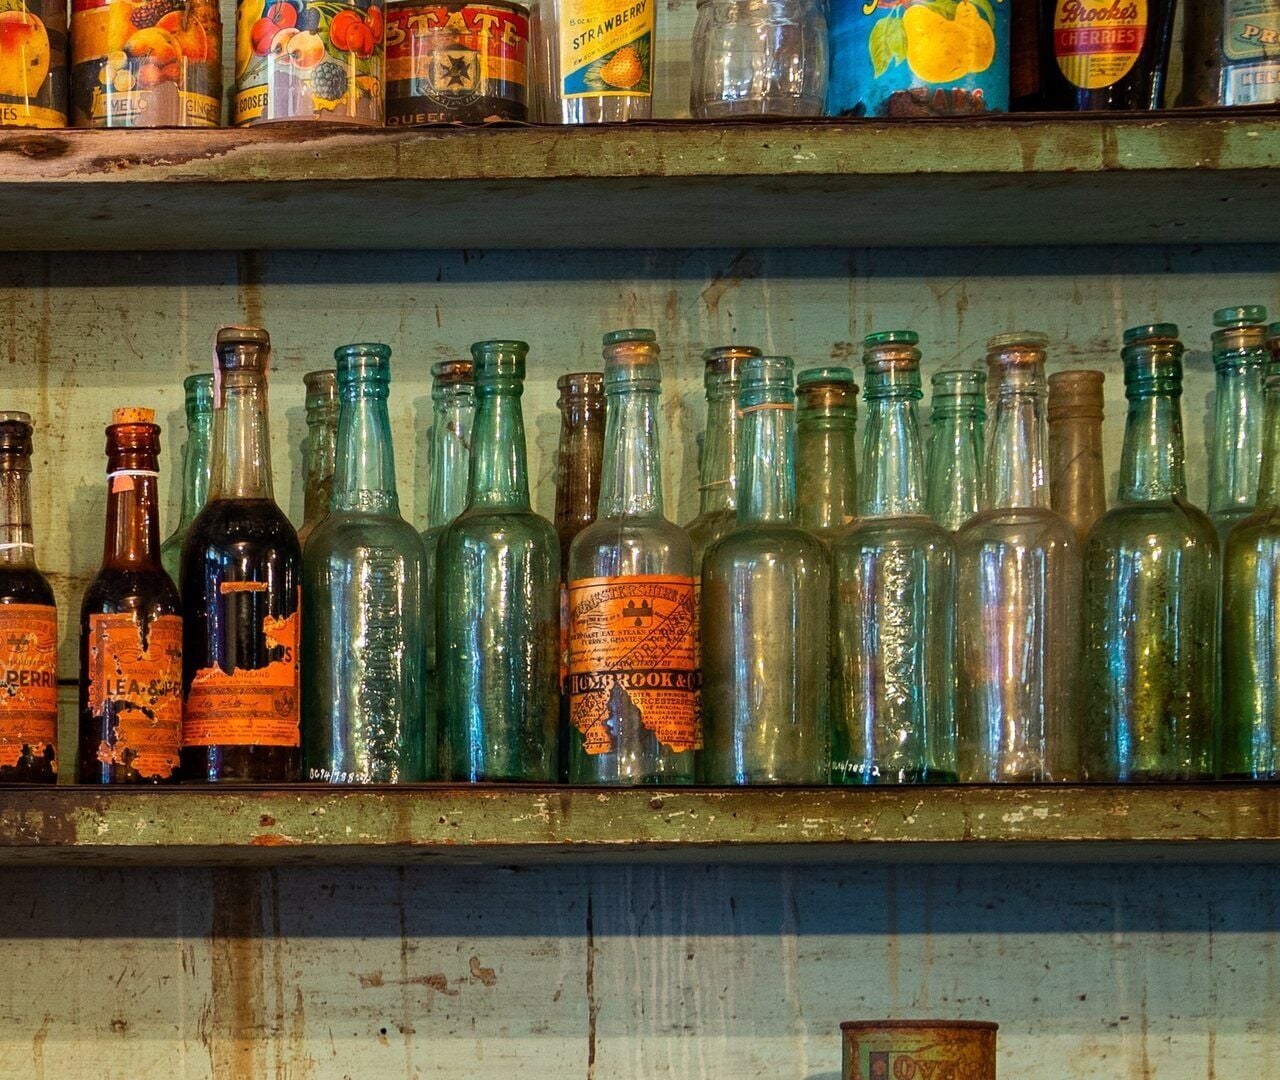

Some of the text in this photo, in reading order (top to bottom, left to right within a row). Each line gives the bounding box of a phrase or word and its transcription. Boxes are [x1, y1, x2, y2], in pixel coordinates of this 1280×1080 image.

[572, 2, 646, 50] STRAWBERRY
[1060, 0, 1138, 23] Brooke's
[386, 11, 521, 47] STATE
[1060, 30, 1135, 46] CHERRIES
